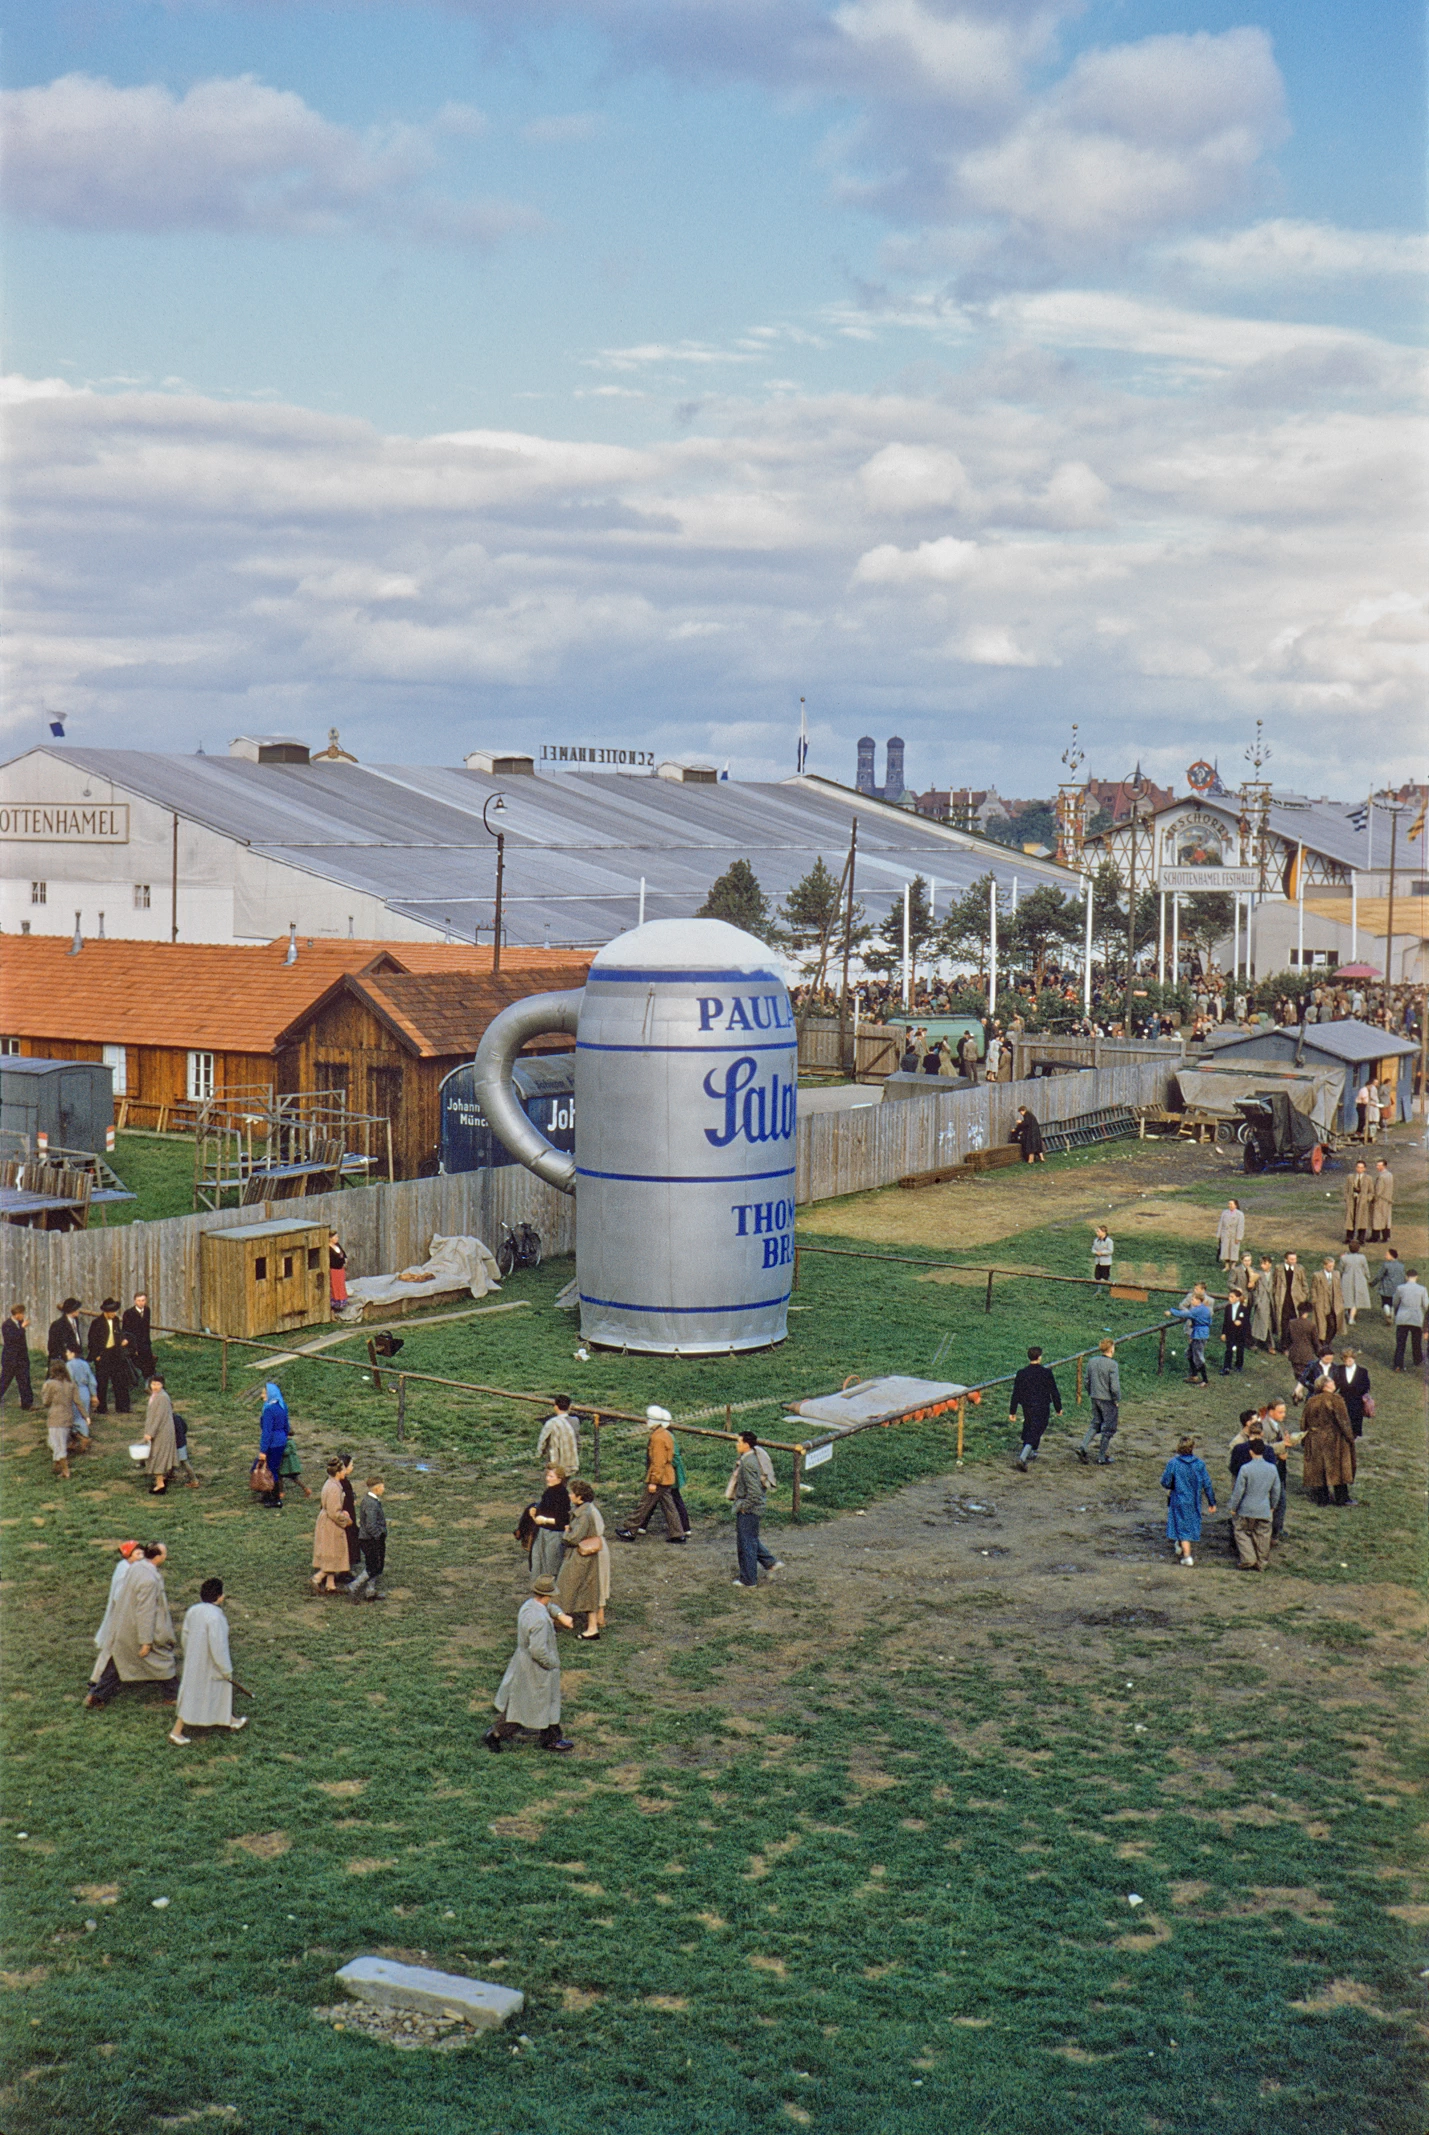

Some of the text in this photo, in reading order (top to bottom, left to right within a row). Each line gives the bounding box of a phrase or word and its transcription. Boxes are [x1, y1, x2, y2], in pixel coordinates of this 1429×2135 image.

[0, 809, 119, 835] OTTENHAMEL
[1163, 871, 1255, 886] SCHOTTENHAMEL FESTHALLE
[447, 1098, 481, 1113] Johann
[762, 1233, 795, 1269] BR
